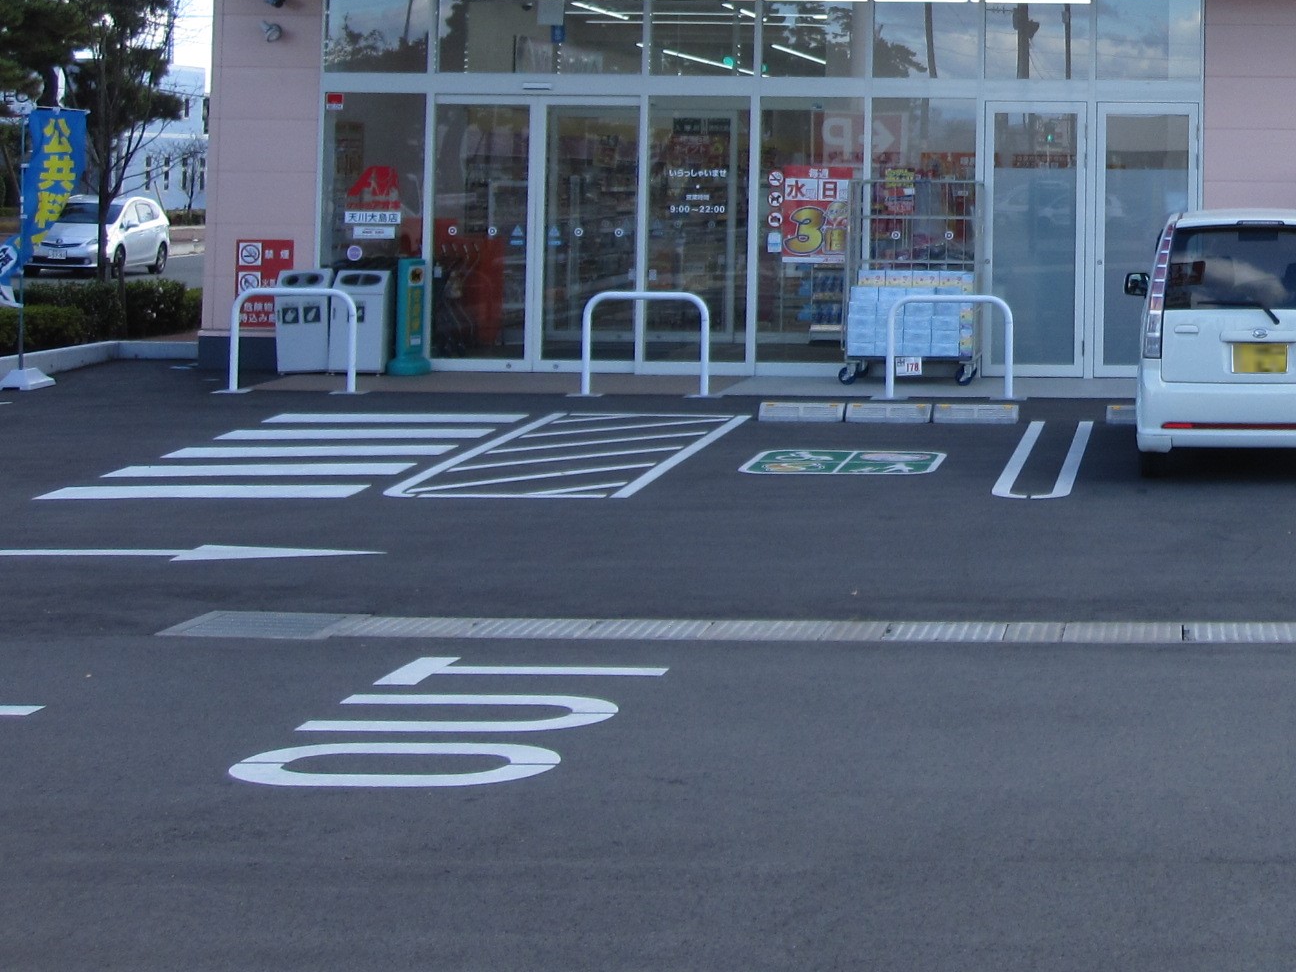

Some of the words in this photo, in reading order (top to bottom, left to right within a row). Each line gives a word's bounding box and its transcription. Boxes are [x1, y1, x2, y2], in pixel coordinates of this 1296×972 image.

[31, 118, 76, 249] 公共料
[668, 169, 727, 178] いらっしゃいませ
[348, 212, 398, 223] 天川大島店
[228, 657, 670, 787] OUT
